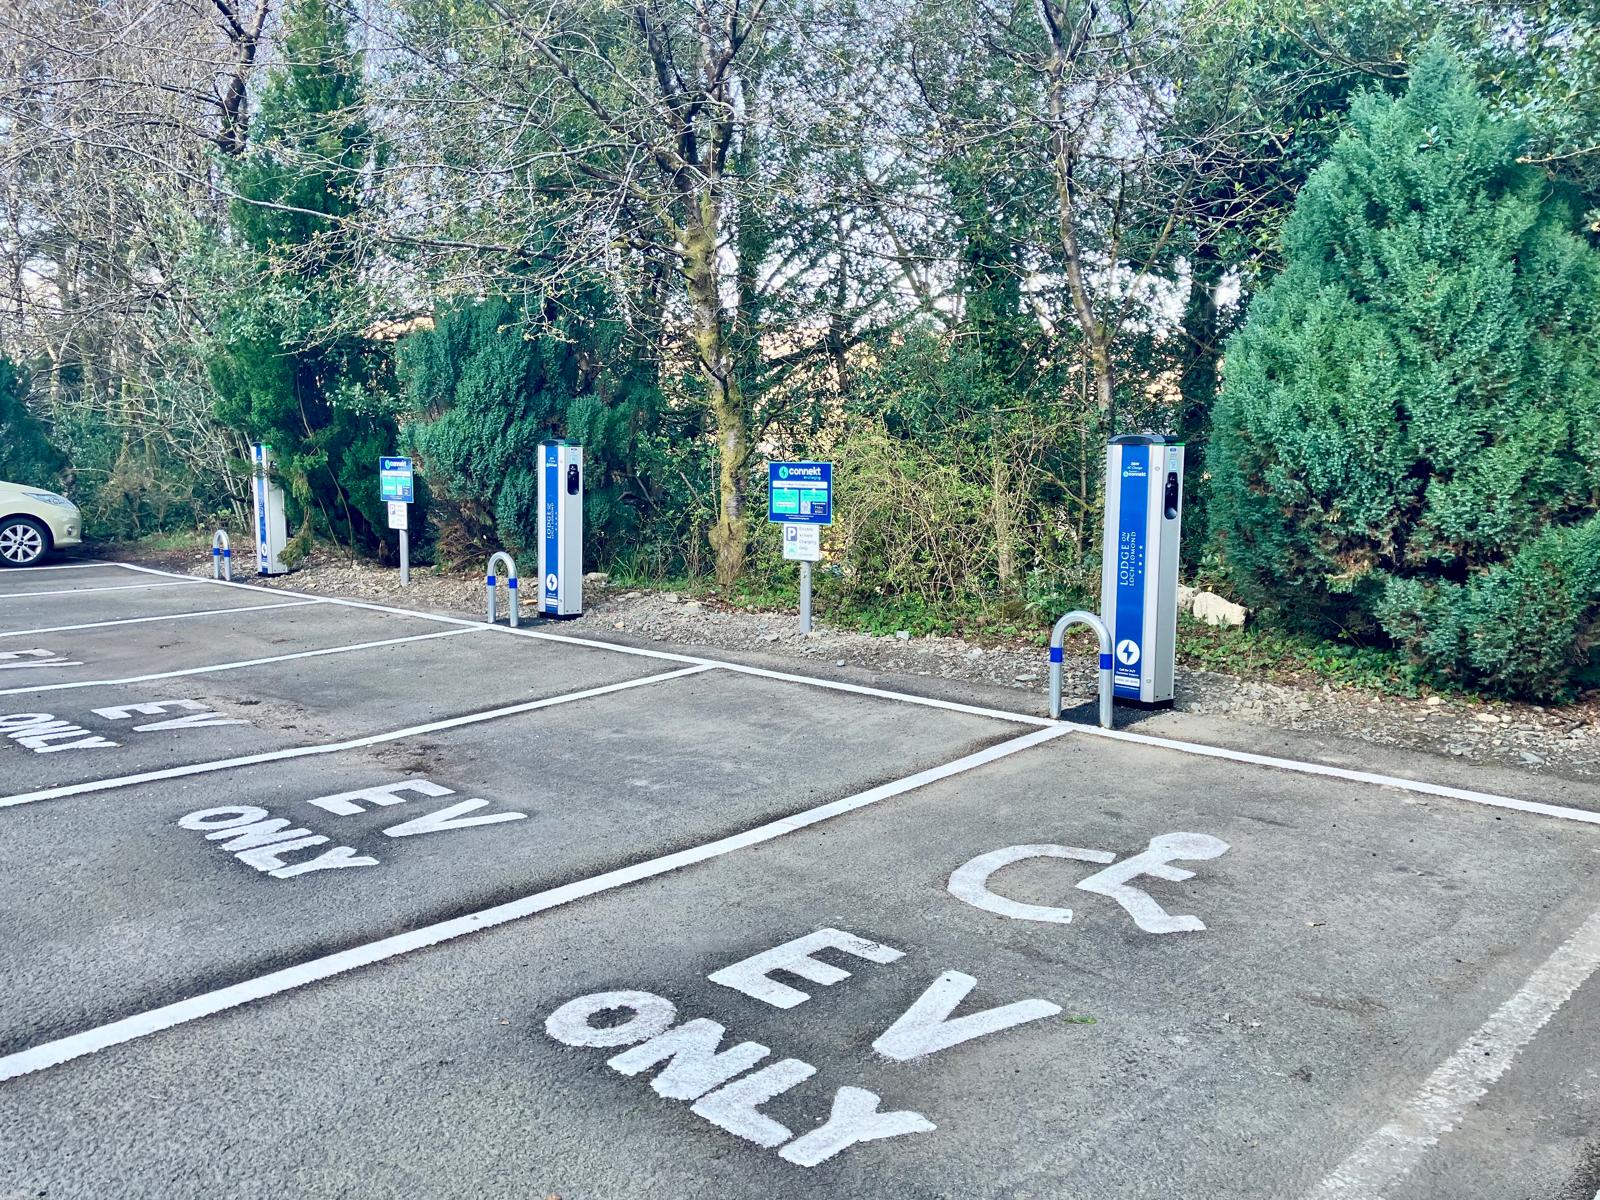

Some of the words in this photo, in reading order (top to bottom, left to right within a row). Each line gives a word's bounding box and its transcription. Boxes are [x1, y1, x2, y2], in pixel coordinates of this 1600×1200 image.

[788, 466, 822, 476] connekt
[1120, 544, 1130, 586] LODGE
[0, 712, 120, 754] ONLY
[91, 699, 252, 732] EV
[307, 778, 528, 837] EV
[178, 805, 380, 879] ONLY
[707, 928, 1063, 1062] EV
[544, 989, 937, 1168] ONLY
